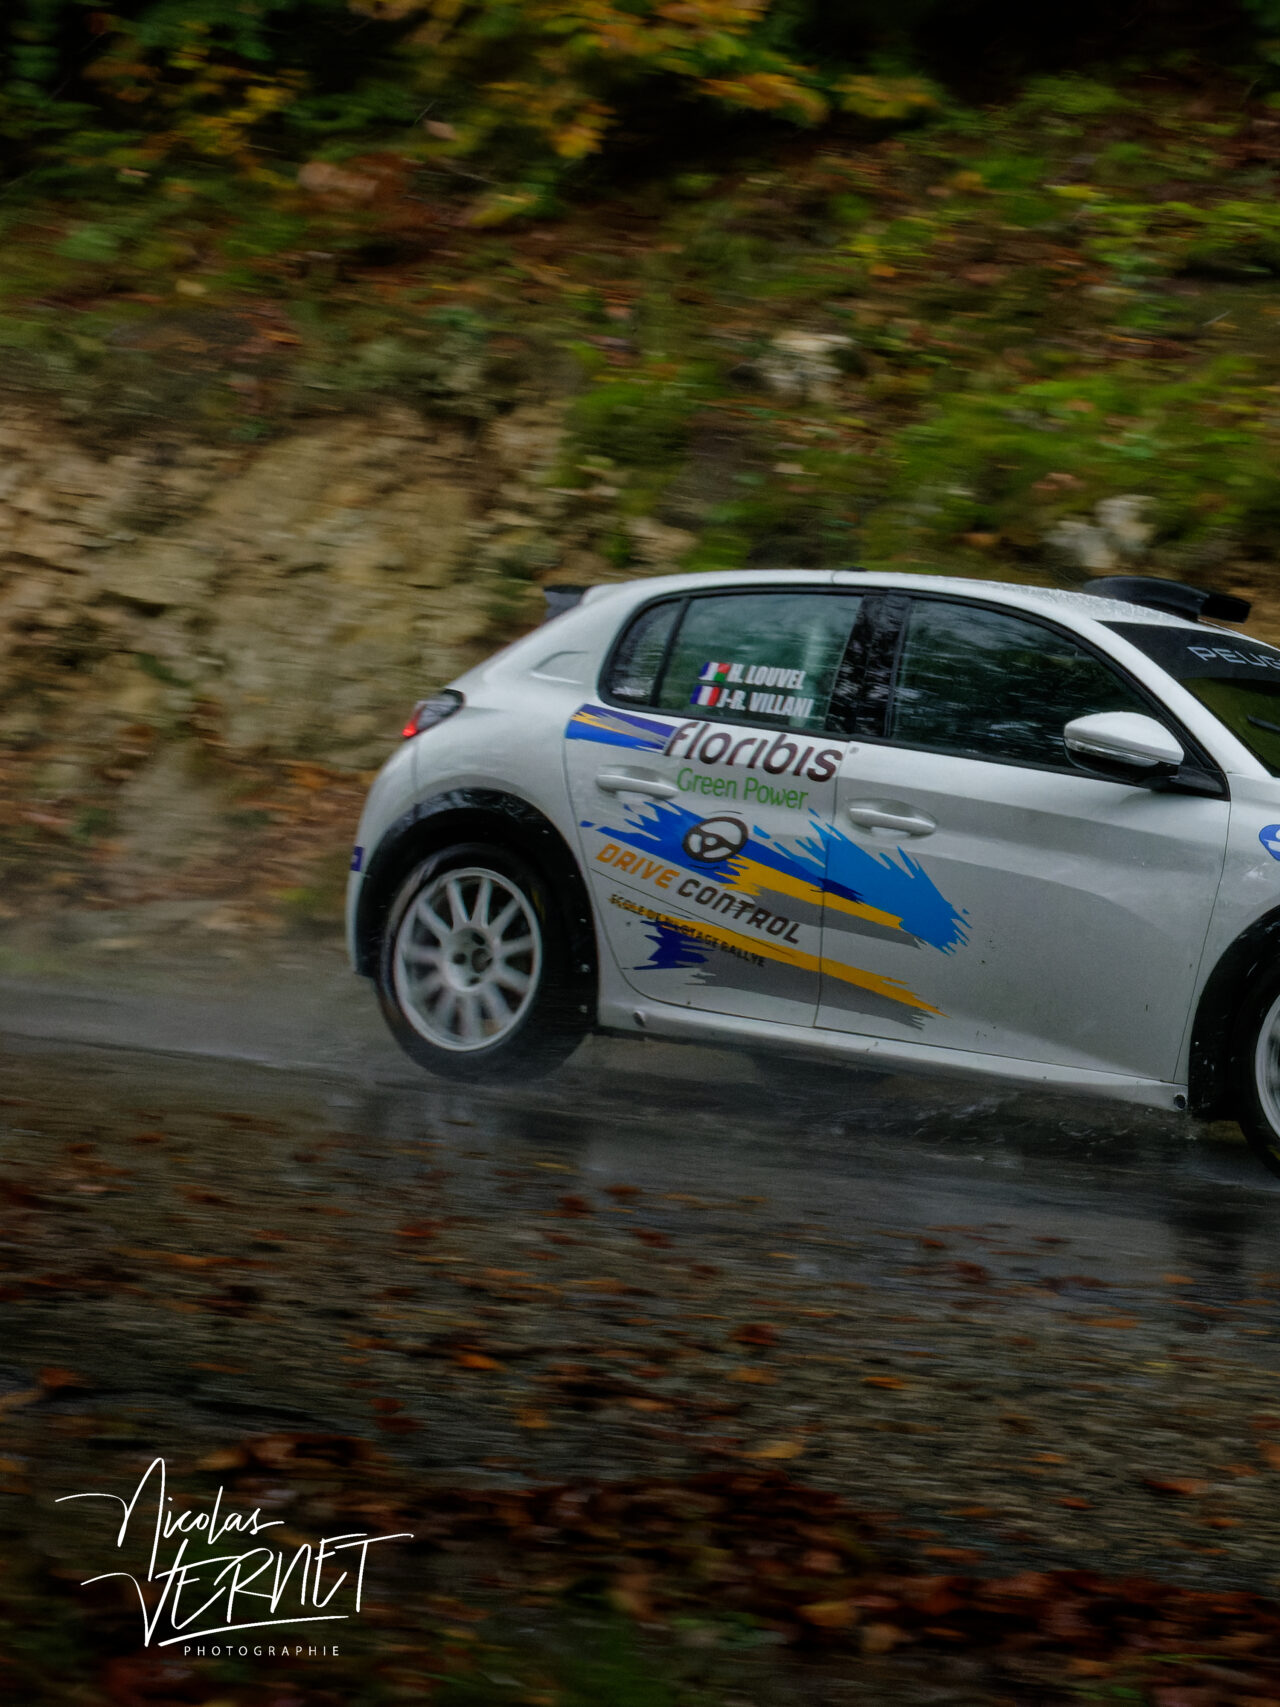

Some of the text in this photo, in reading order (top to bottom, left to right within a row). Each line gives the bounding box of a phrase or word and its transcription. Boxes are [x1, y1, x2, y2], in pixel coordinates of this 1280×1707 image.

[727, 663, 807, 690] H. LOUVEL
[748, 691, 815, 718] VILLANI
[663, 720, 844, 782] floribis
[676, 767, 809, 810] Green Power
[596, 842, 800, 944] DRIVE CONTROL
